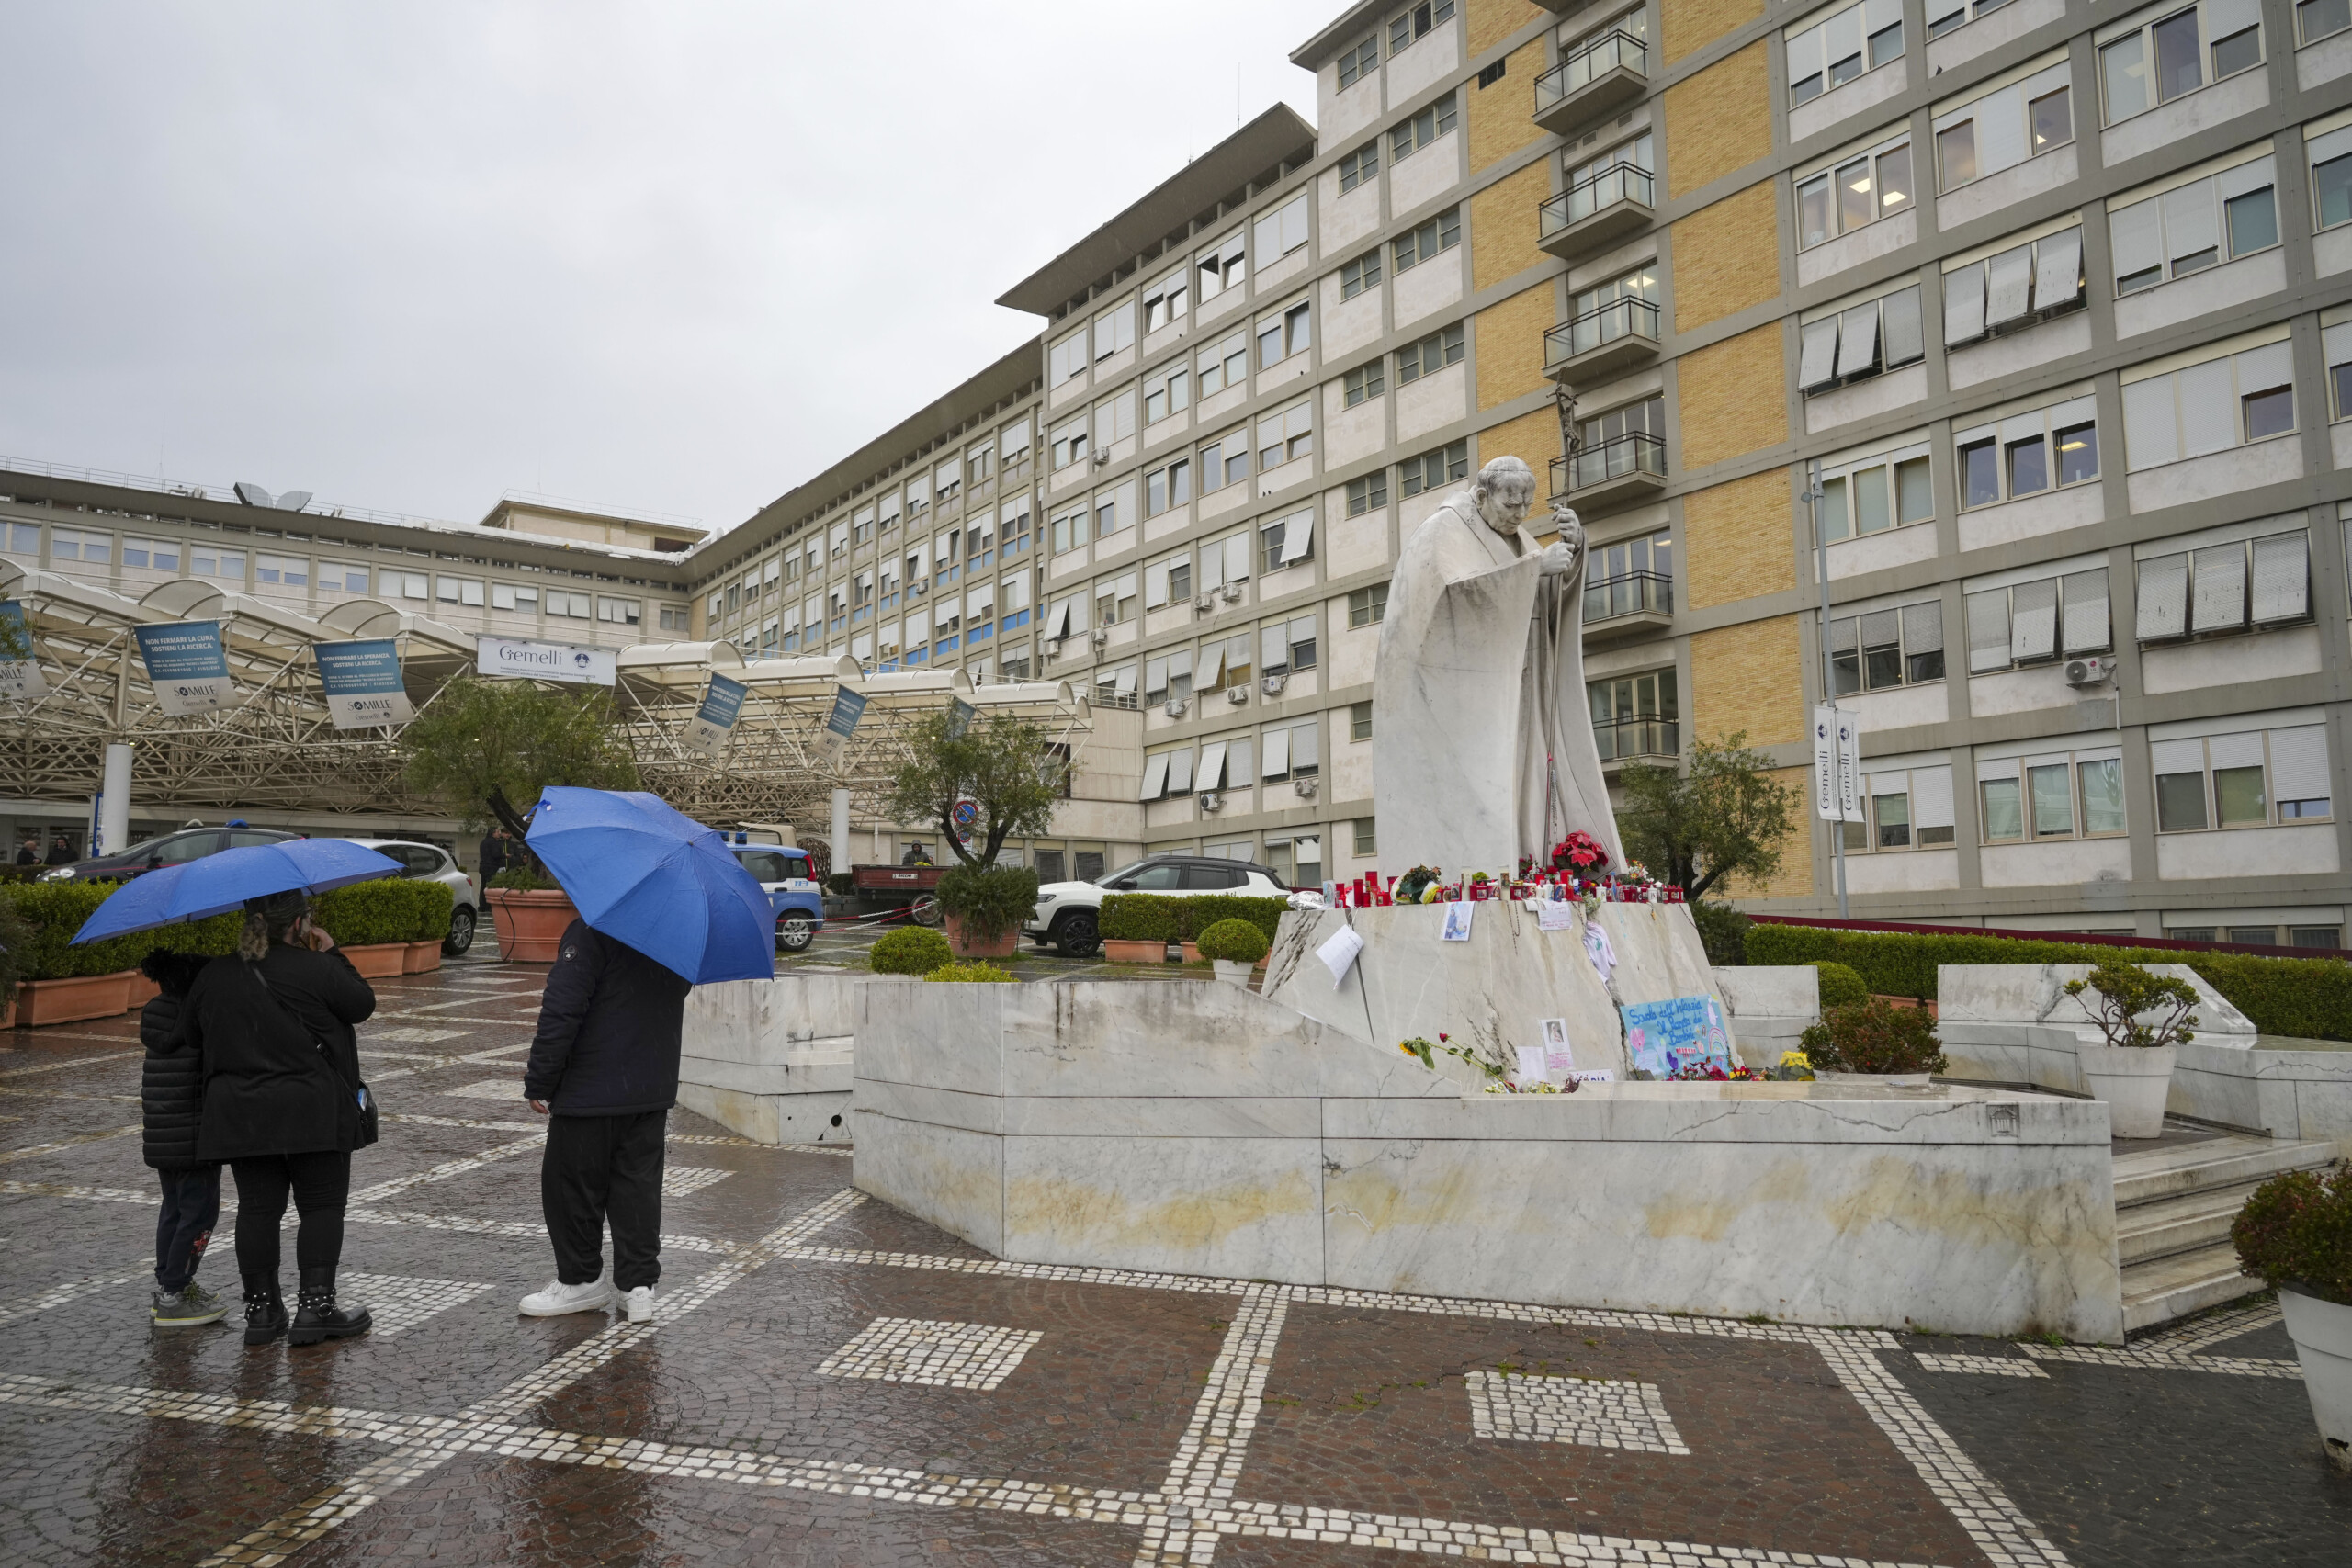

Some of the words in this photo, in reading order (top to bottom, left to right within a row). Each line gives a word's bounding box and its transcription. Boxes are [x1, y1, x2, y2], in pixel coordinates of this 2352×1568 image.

[160, 637, 187, 645] FERMARE
[499, 645, 562, 666] Gemelli
[1819, 750, 1829, 809] Gemelli
[1841, 753, 1852, 810] Gemelli
[1629, 1004, 1657, 1025] Scuola
